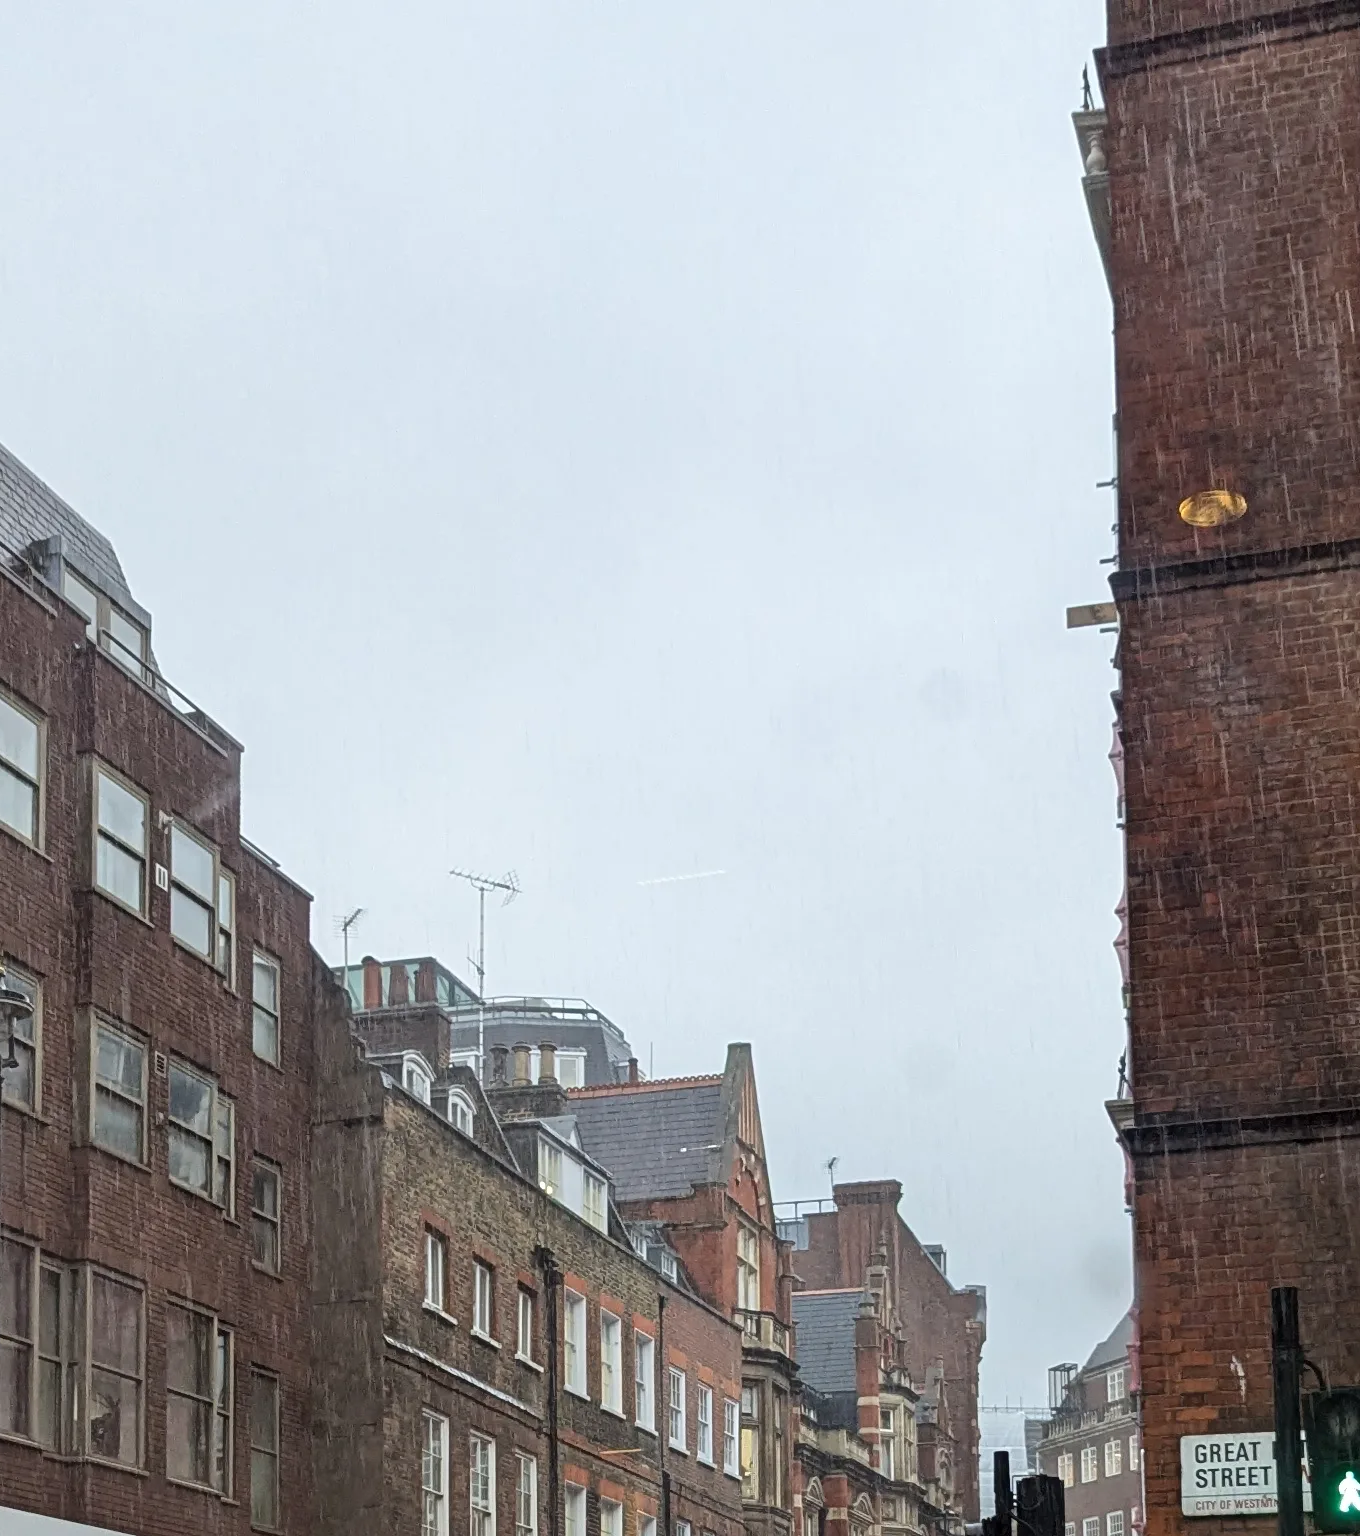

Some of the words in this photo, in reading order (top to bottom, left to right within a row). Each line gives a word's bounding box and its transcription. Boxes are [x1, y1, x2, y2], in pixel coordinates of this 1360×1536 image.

[1194, 1441, 1261, 1464] GREAT
[1195, 1465, 1272, 1489] STREET
[1195, 1500, 1216, 1511] CITY
[1220, 1499, 1232, 1510] OF
[1234, 1497, 1279, 1509] WESTMIN
